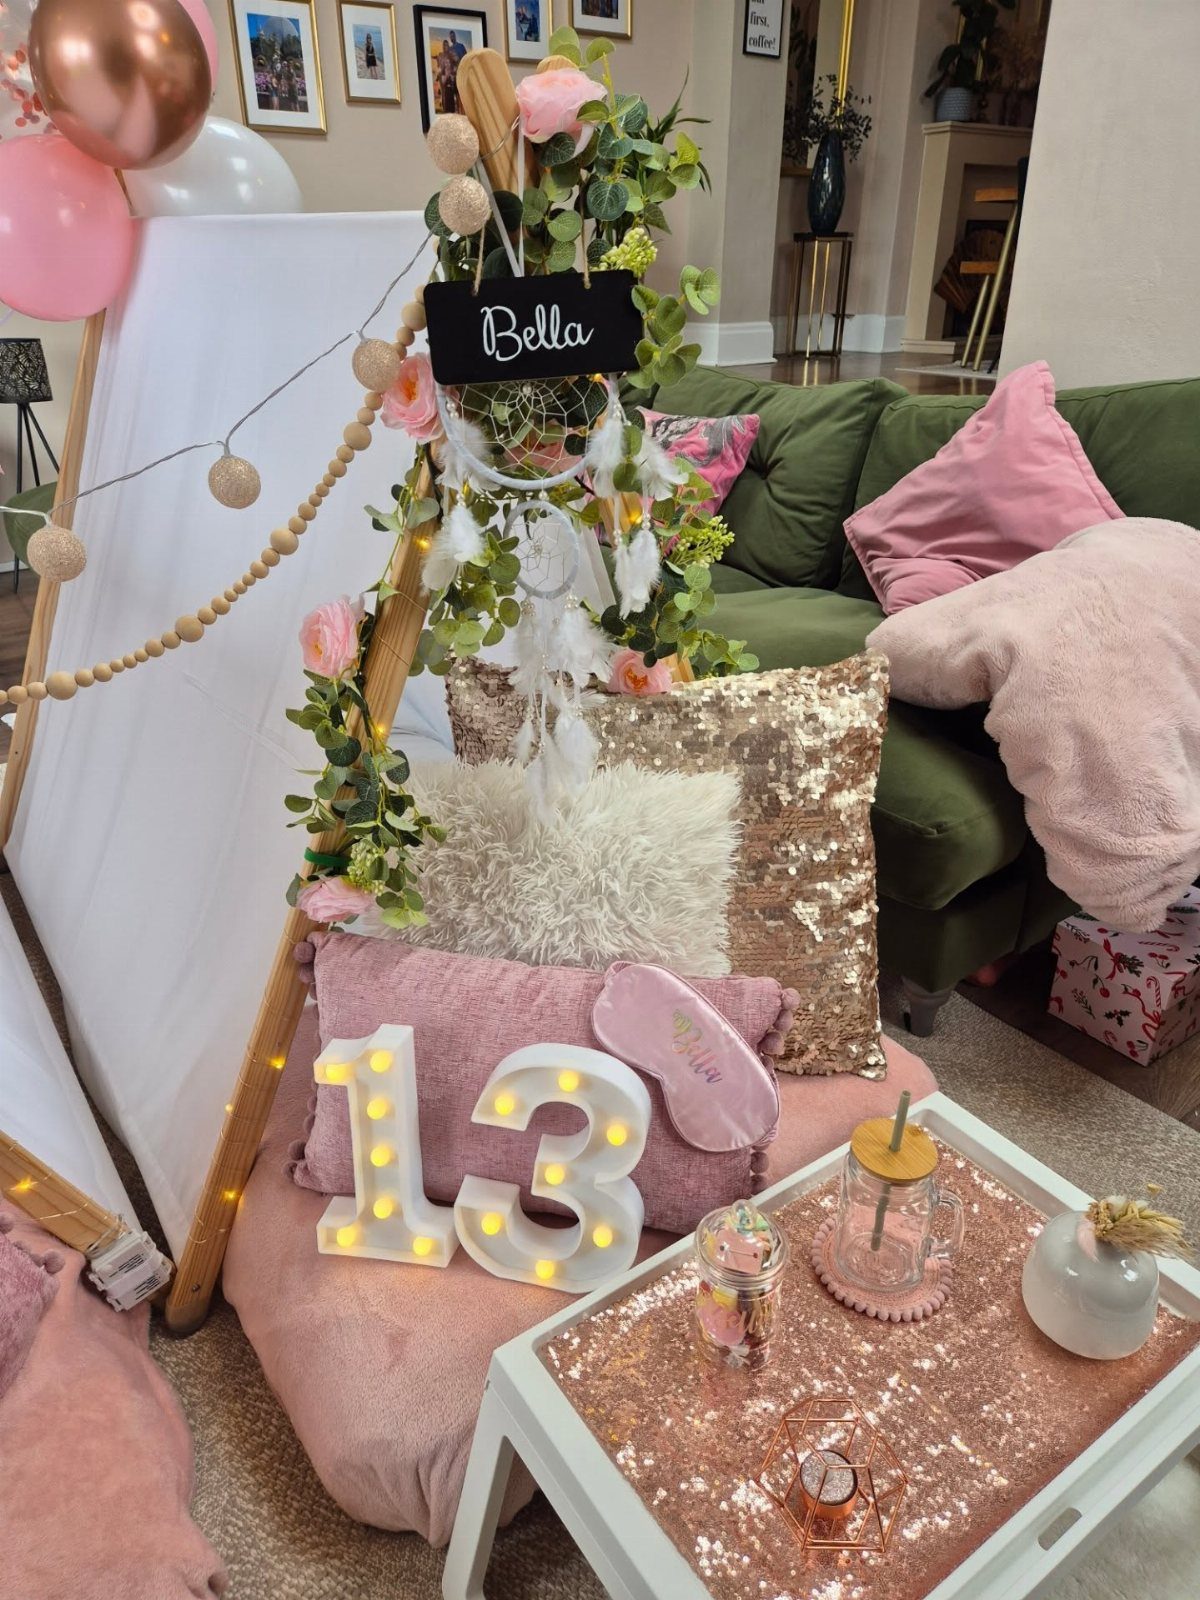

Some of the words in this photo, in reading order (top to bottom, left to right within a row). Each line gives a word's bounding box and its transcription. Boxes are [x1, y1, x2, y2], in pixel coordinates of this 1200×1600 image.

[748, 34, 776, 50] coffee!
[480, 304, 594, 362] Bella
[314, 1023, 652, 1294] 13
